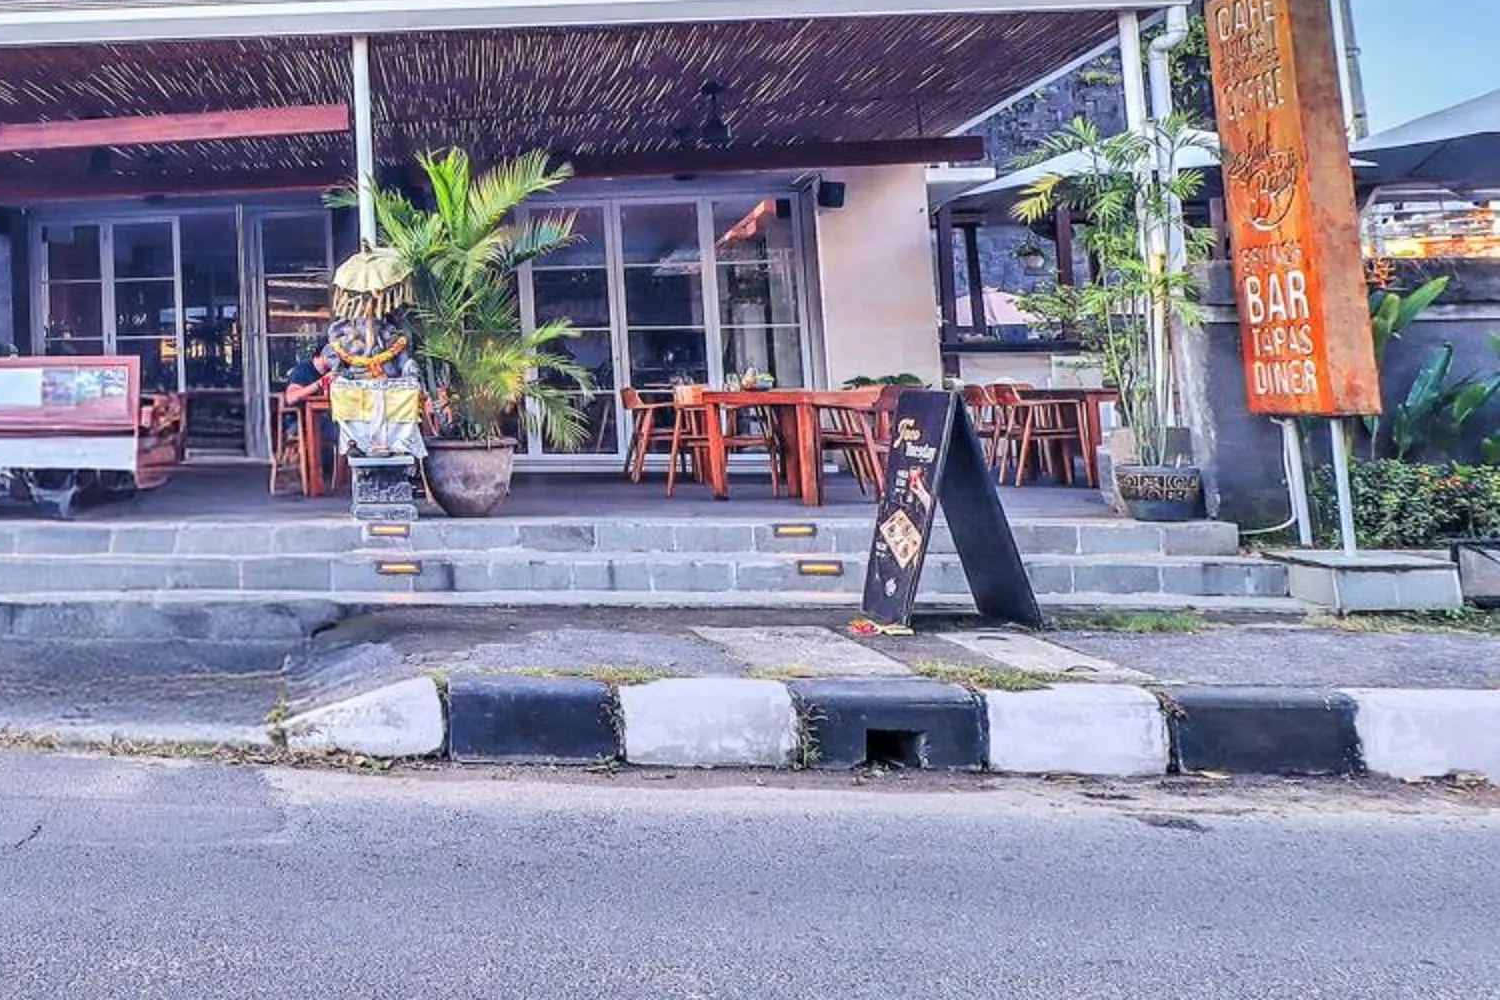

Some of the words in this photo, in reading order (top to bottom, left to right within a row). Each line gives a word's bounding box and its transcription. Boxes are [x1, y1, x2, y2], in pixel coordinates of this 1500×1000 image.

[1245, 269, 1310, 325] BAR
[1251, 323, 1314, 357] TAPAS
[1254, 359, 1318, 396] DINER
